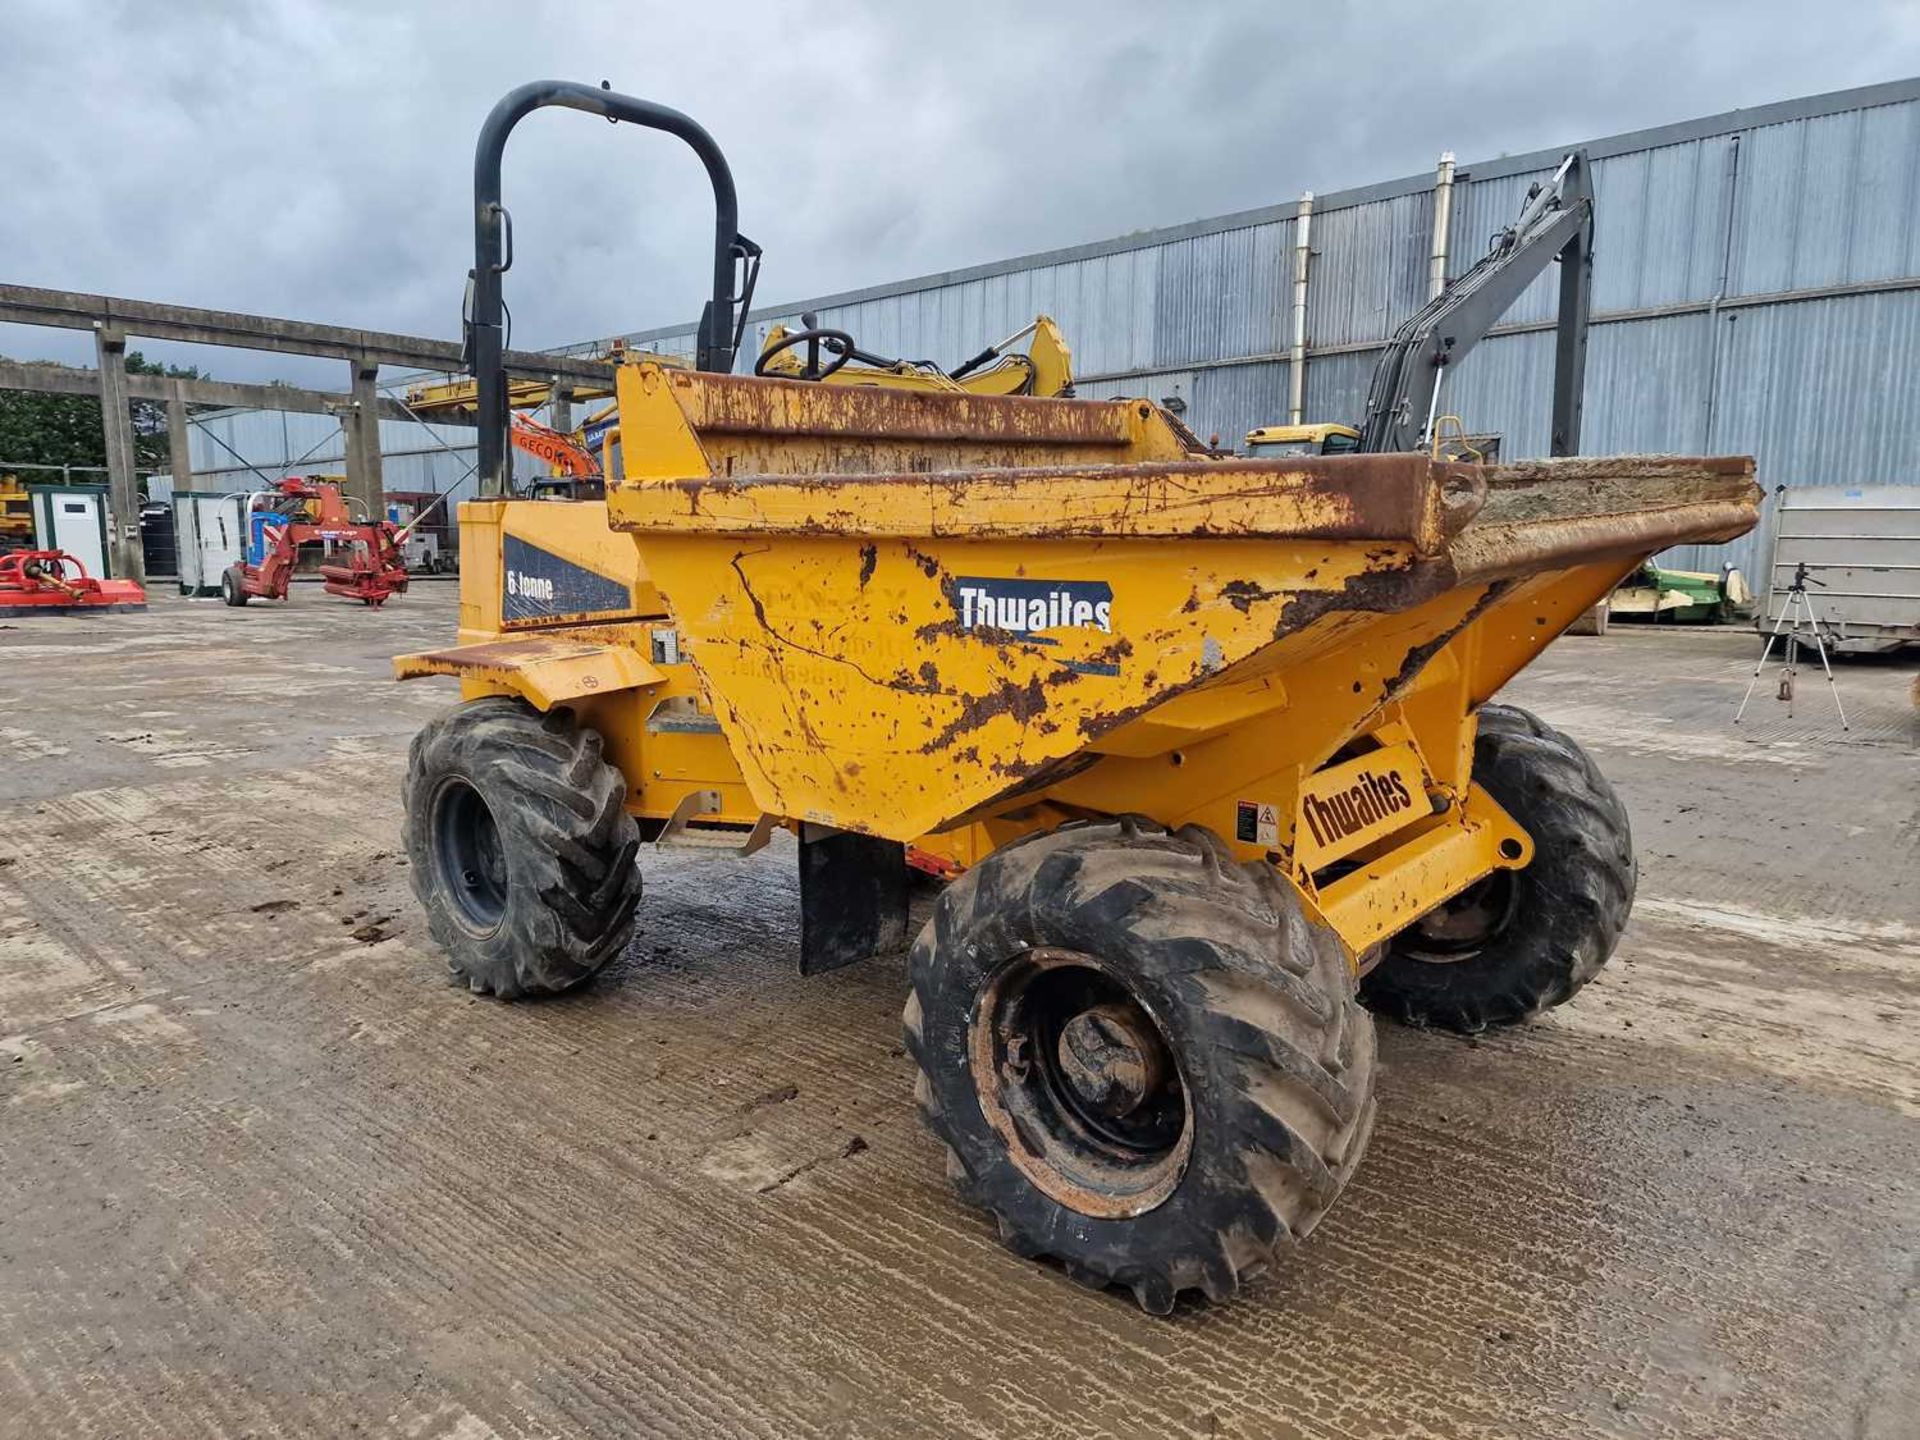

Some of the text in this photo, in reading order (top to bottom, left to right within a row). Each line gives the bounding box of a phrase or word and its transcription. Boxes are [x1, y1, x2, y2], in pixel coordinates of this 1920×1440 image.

[508, 570, 554, 600] 6 tonne
[960, 587, 1112, 634] Thwaites
[1303, 769, 1411, 848] Thwaites
